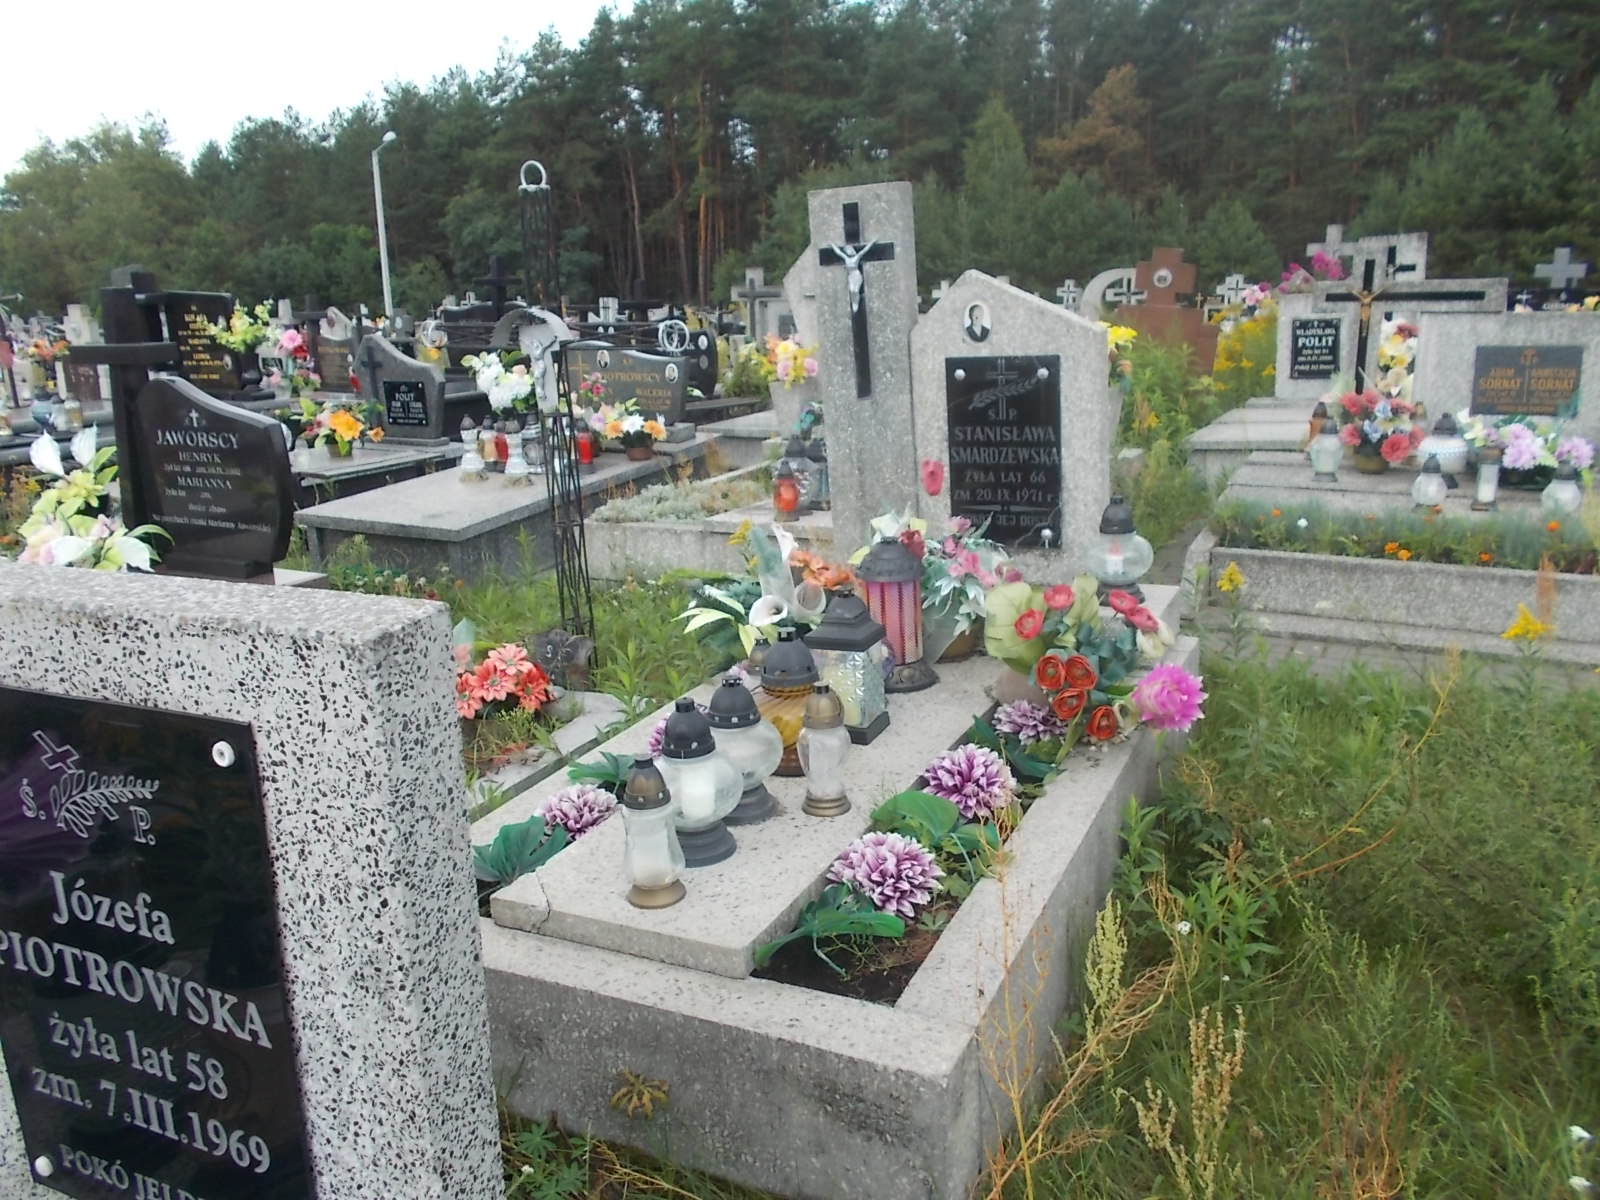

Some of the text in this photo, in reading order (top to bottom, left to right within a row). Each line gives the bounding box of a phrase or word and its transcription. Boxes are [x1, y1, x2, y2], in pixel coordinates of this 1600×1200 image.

[1298, 336, 1335, 348] POLIT
[1480, 378, 1522, 390] SORNAT
[1531, 378, 1575, 391] SORNAT
[156, 429, 239, 449] JAWORSCY
[954, 426, 1056, 442] STANISŁAWA
[179, 451, 222, 463] HENRYK
[951, 446, 1061, 466] SMARDZEWSKA
[177, 475, 233, 490] MARIANNA
[1001, 471, 1022, 483] LAT
[1030, 470, 1046, 483] 66
[129, 805, 156, 846] P.
[49, 870, 176, 945] Józefa
[50, 1011, 229, 1100] żyła lat 58
[31, 1067, 94, 1109] zm.
